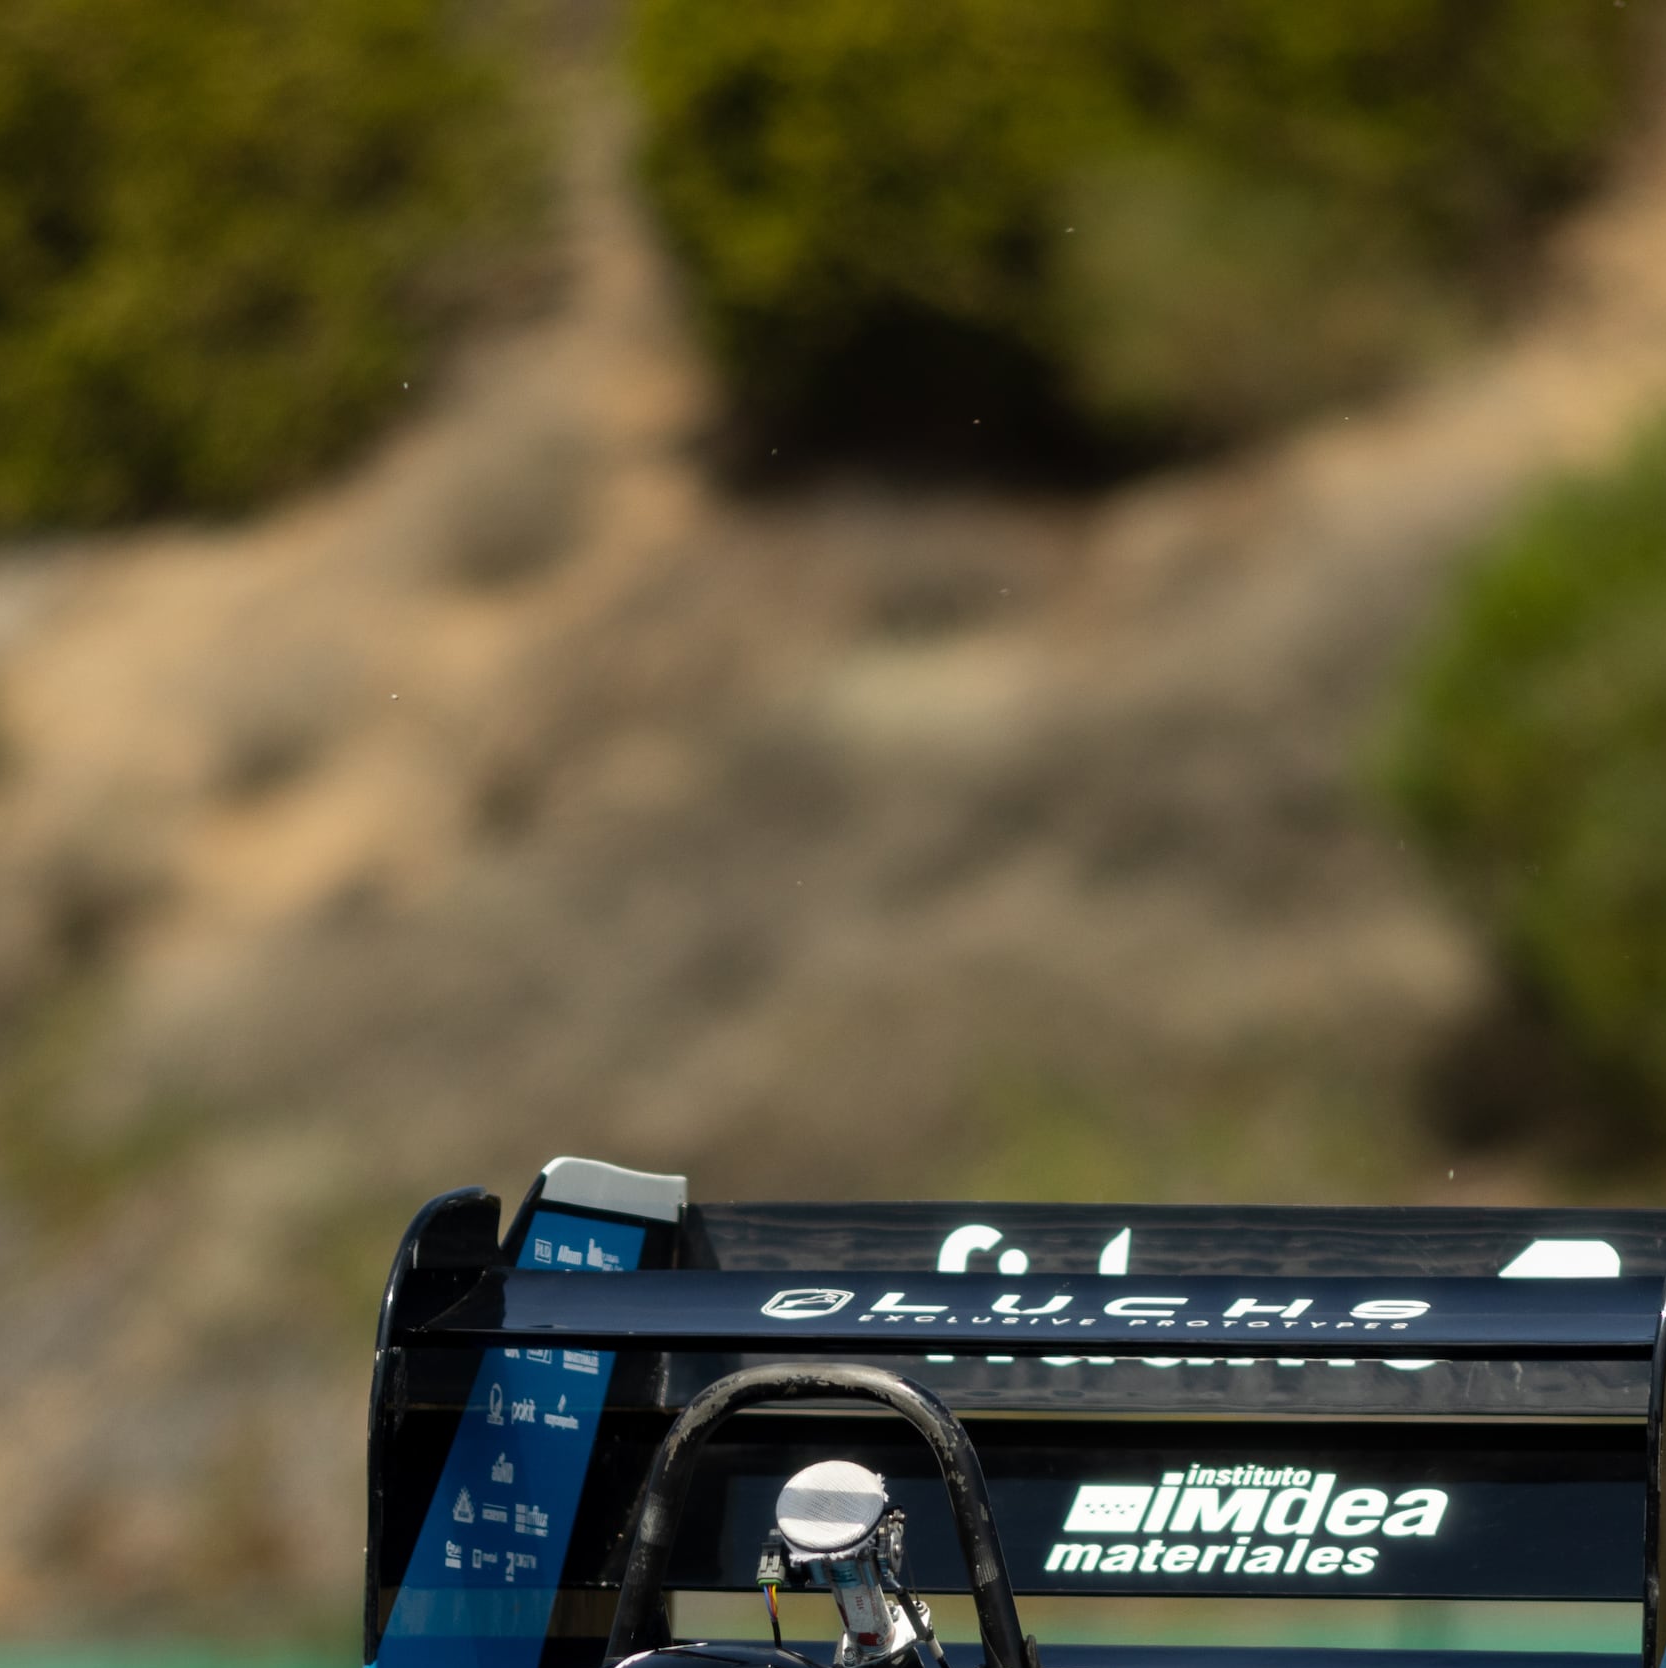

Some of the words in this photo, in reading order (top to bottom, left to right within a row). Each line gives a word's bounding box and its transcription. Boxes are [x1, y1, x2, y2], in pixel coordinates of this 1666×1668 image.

[870, 1292, 1431, 1320] LUCHS
[858, 1314, 1097, 1326] EXCLUSIVE
[1129, 1319, 1409, 1330] PROTOTYPES
[1186, 1463, 1312, 1486] instituto
[1044, 1536, 1380, 1576] materiales
